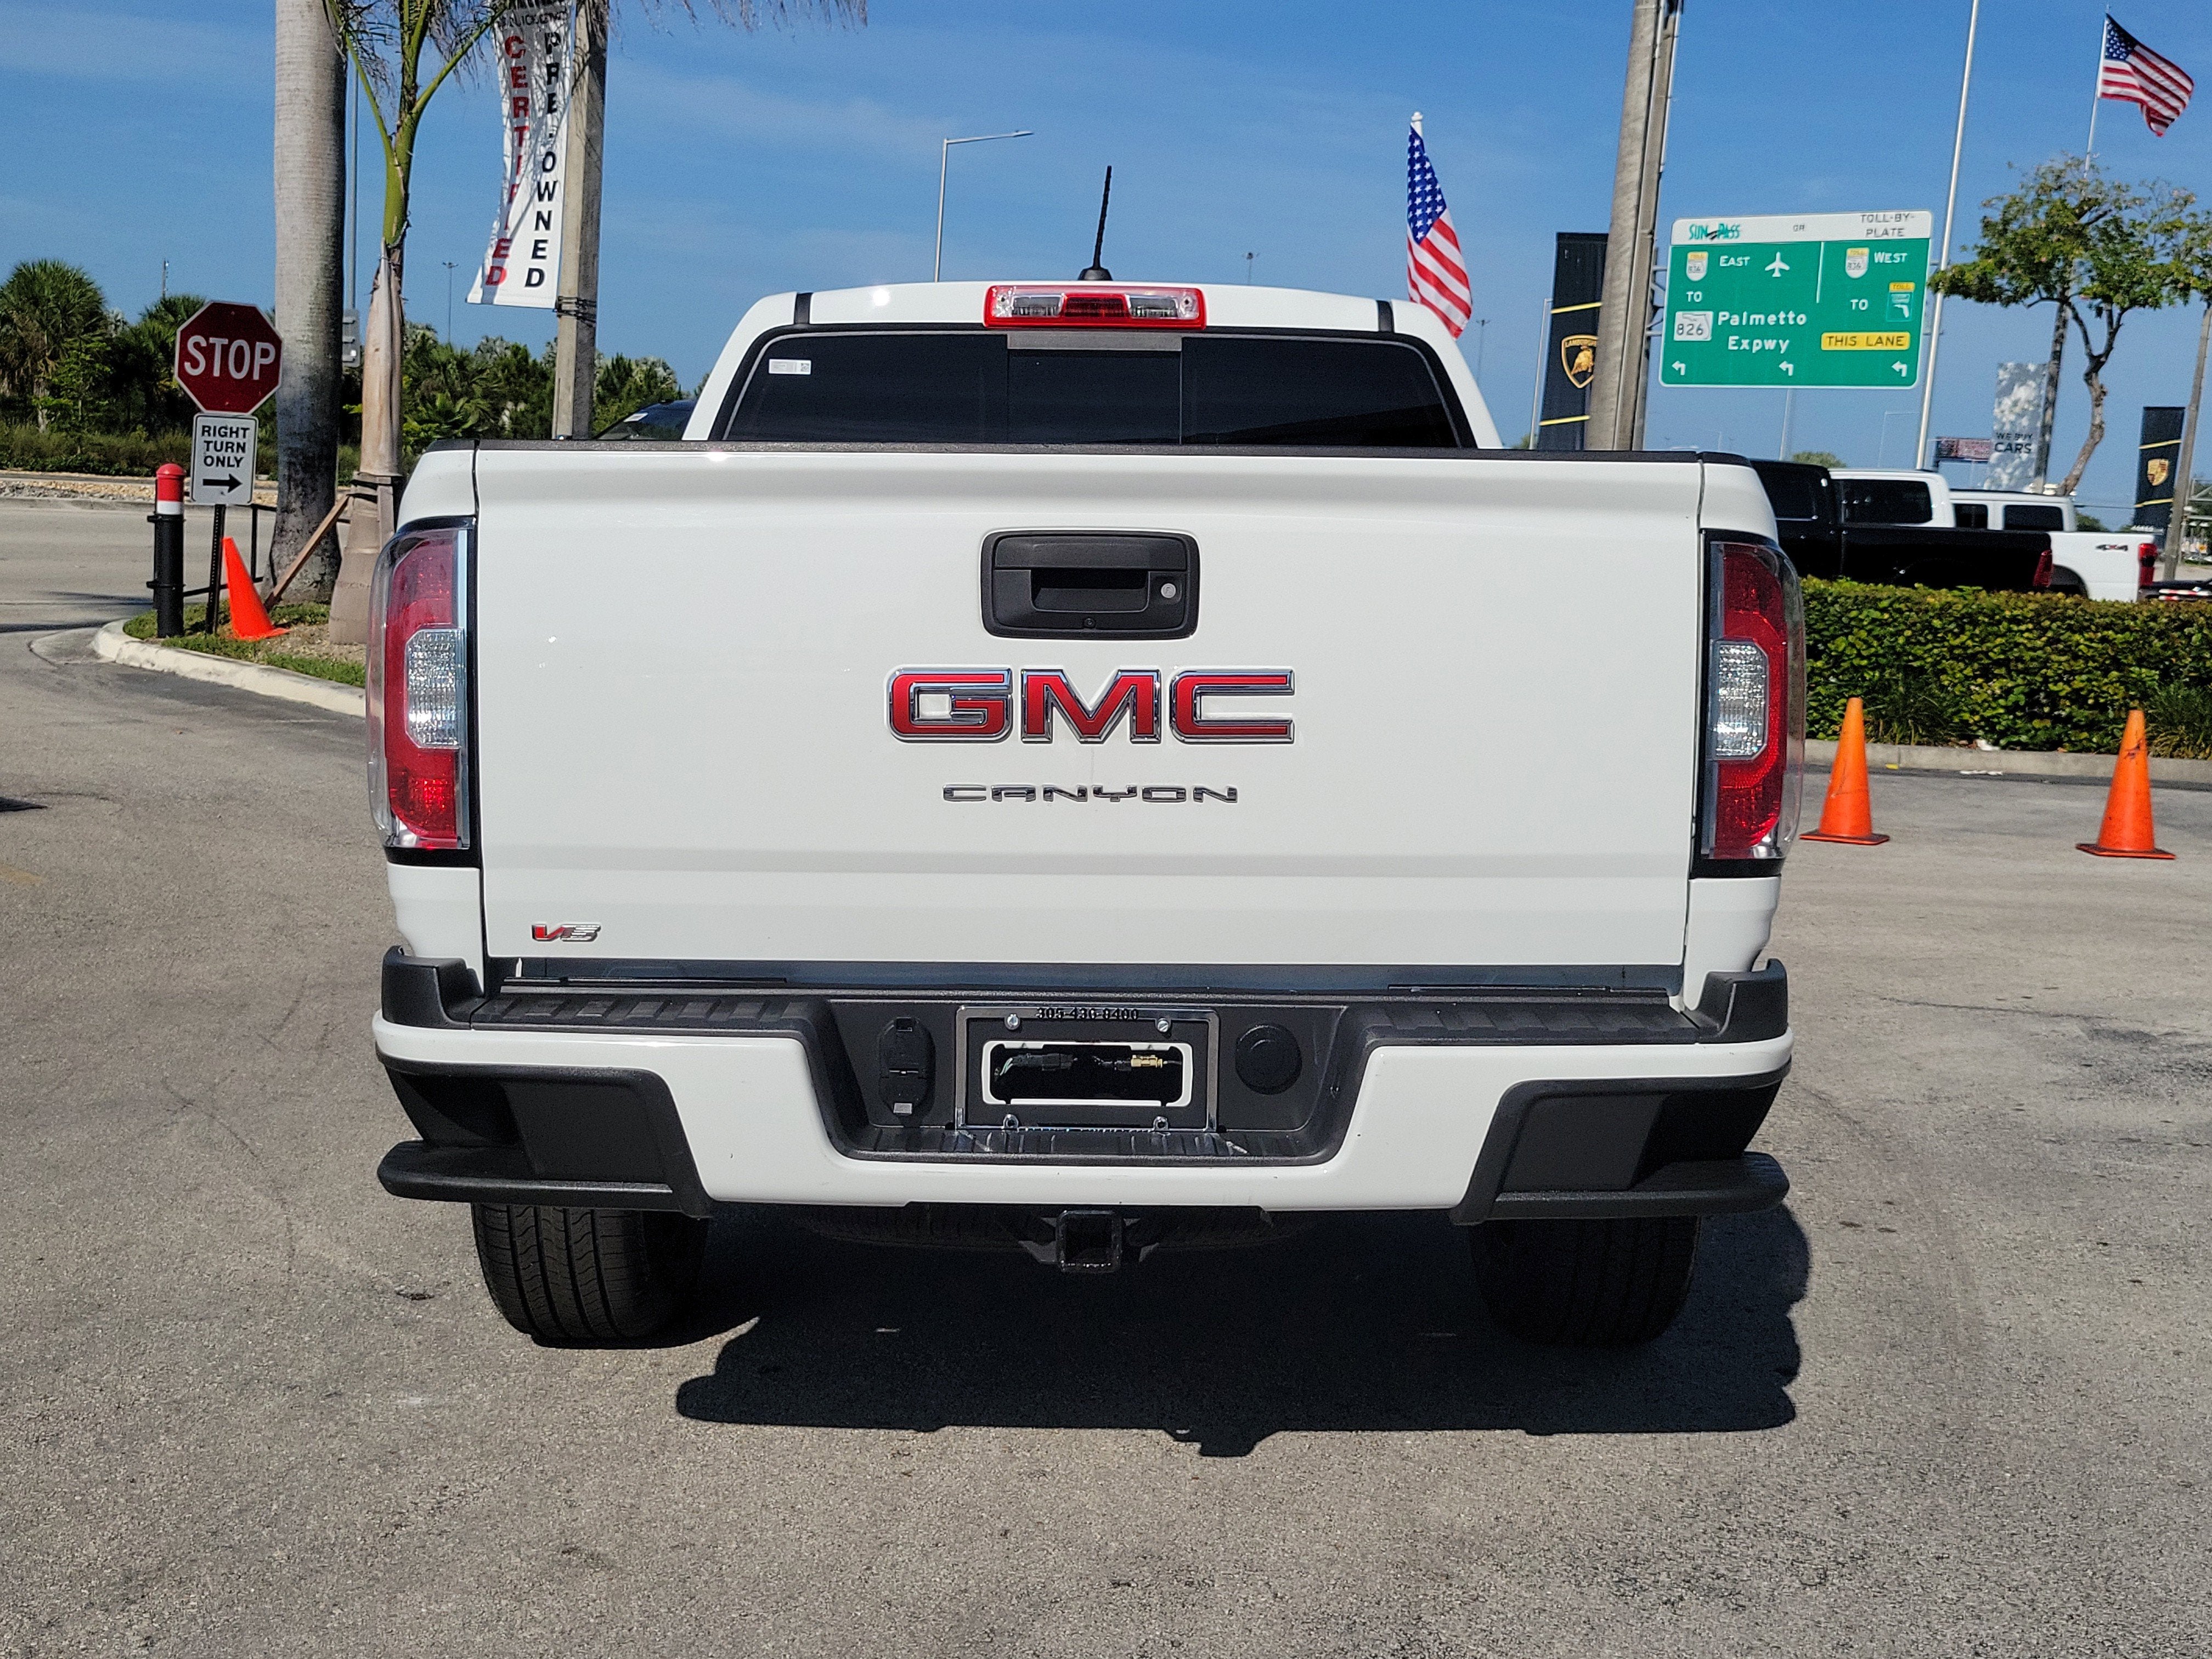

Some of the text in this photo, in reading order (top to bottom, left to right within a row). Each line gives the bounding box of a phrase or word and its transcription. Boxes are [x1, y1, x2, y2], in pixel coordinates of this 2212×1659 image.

[1865, 228, 1905, 238] PLATE
[1719, 255, 1751, 267] EAST
[1874, 252, 1908, 263] WEST
[1686, 291, 1703, 302] TO
[1850, 299, 1869, 311] TO
[1718, 311, 1807, 326] Palmetto
[1677, 323, 1704, 336] 826
[1728, 335, 1790, 353] Expwy
[1826, 335, 1905, 347] THIS LANE
[184, 335, 275, 381] STOP
[201, 424, 250, 439] RIGHT
[204, 440, 246, 454] TURN
[1994, 442, 2033, 454] CARS
[203, 455, 244, 468] ONLY
[887, 667, 1295, 746] GMC
[941, 784, 1239, 804] CANYON
